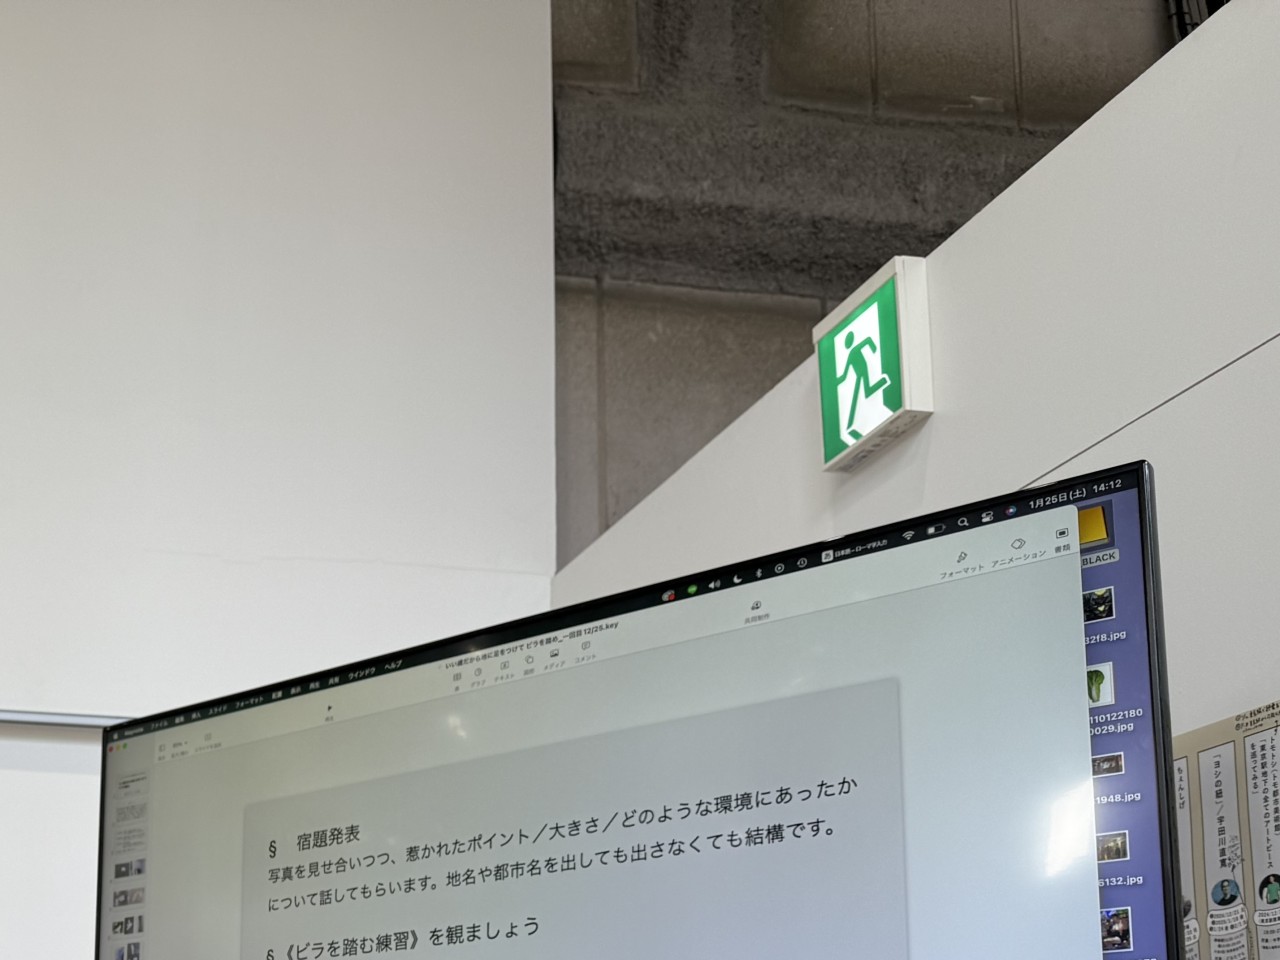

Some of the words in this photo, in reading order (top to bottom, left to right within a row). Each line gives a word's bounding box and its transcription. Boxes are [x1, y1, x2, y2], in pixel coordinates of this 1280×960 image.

[1092, 478, 1123, 494] 14:12
[1082, 552, 1116, 566] BLACK
[296, 823, 361, 853] 宿題発表
[267, 817, 835, 912] について話してもらいます。地名や都市名を出しても出さなくても結構です。
